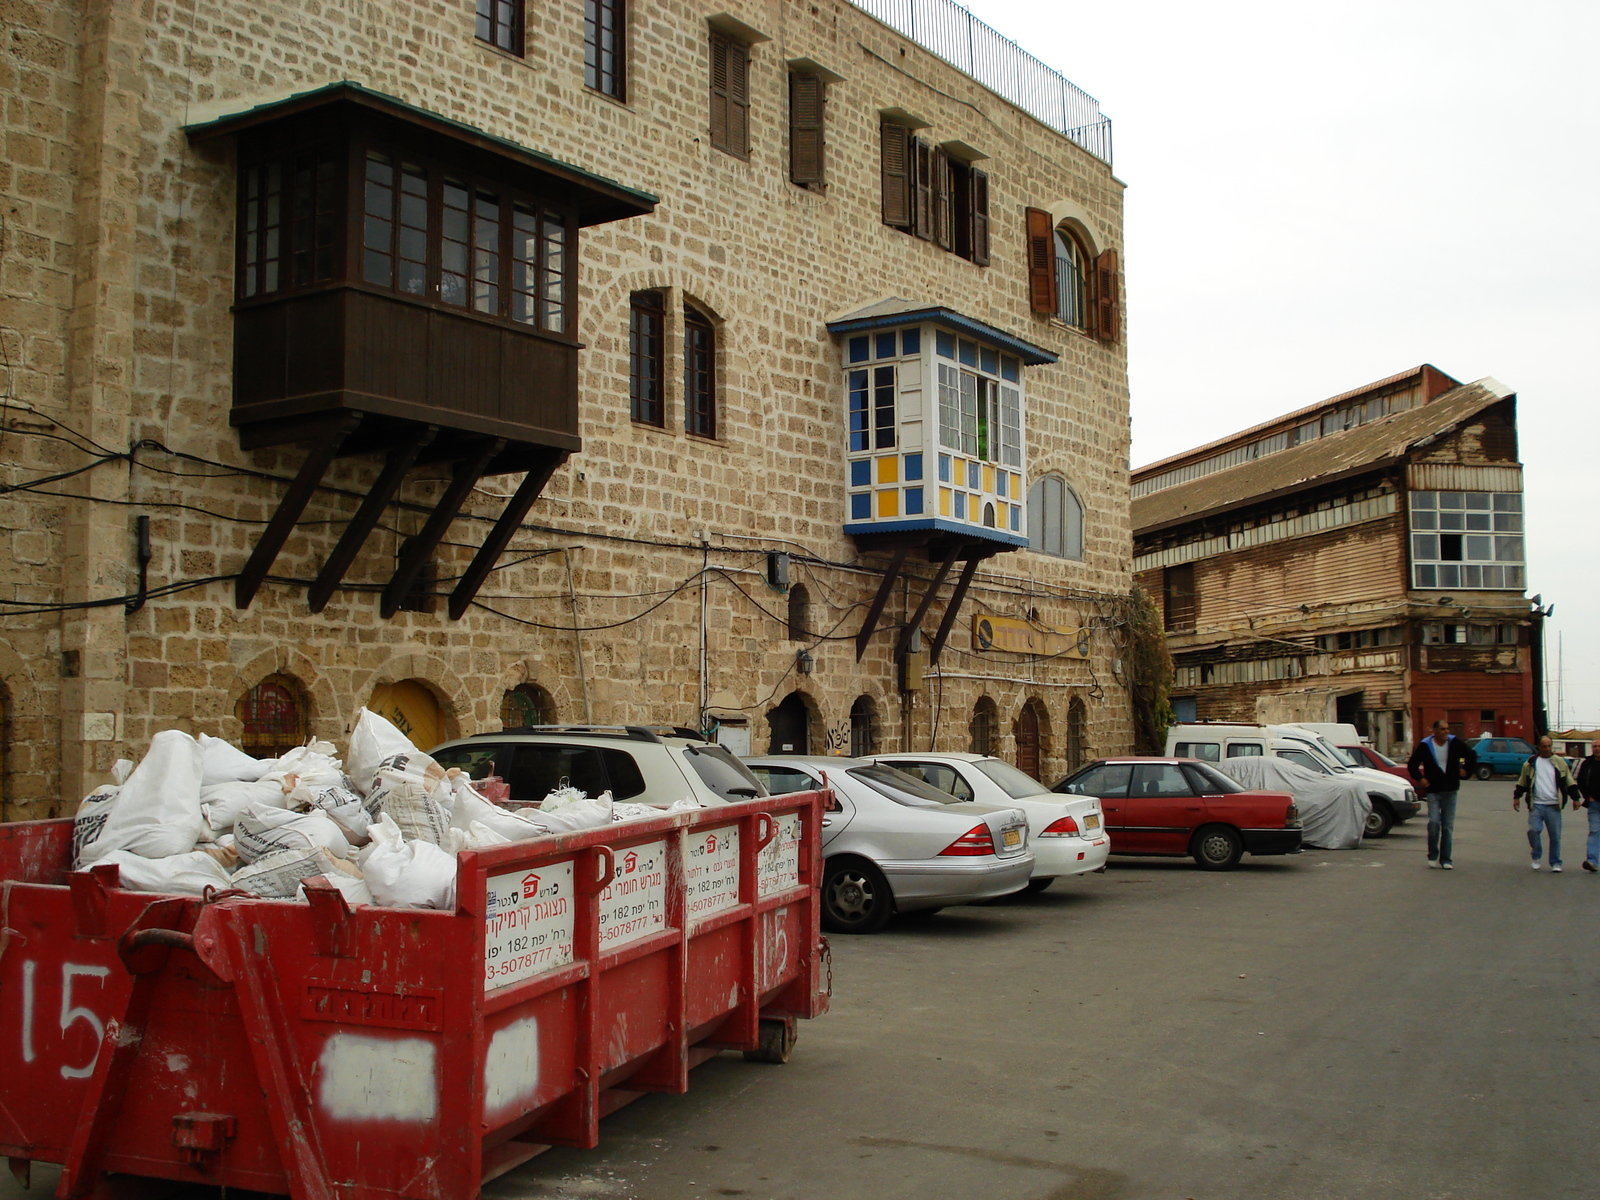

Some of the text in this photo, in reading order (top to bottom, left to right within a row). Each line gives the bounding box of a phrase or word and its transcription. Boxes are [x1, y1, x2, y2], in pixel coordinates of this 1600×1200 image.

[615, 878, 638, 896] חומרי
[640, 872, 661, 890] מגרש
[698, 880, 711, 894] 182
[540, 883, 559, 898] כורש
[497, 891, 519, 908] סנטר
[534, 898, 567, 921] תצוגת
[613, 905, 629, 920] 182
[631, 904, 645, 916] יפת
[508, 936, 528, 954] 182
[531, 934, 548, 948] יפת
[761, 907, 788, 987] 15
[22, 959, 111, 1080] 15
